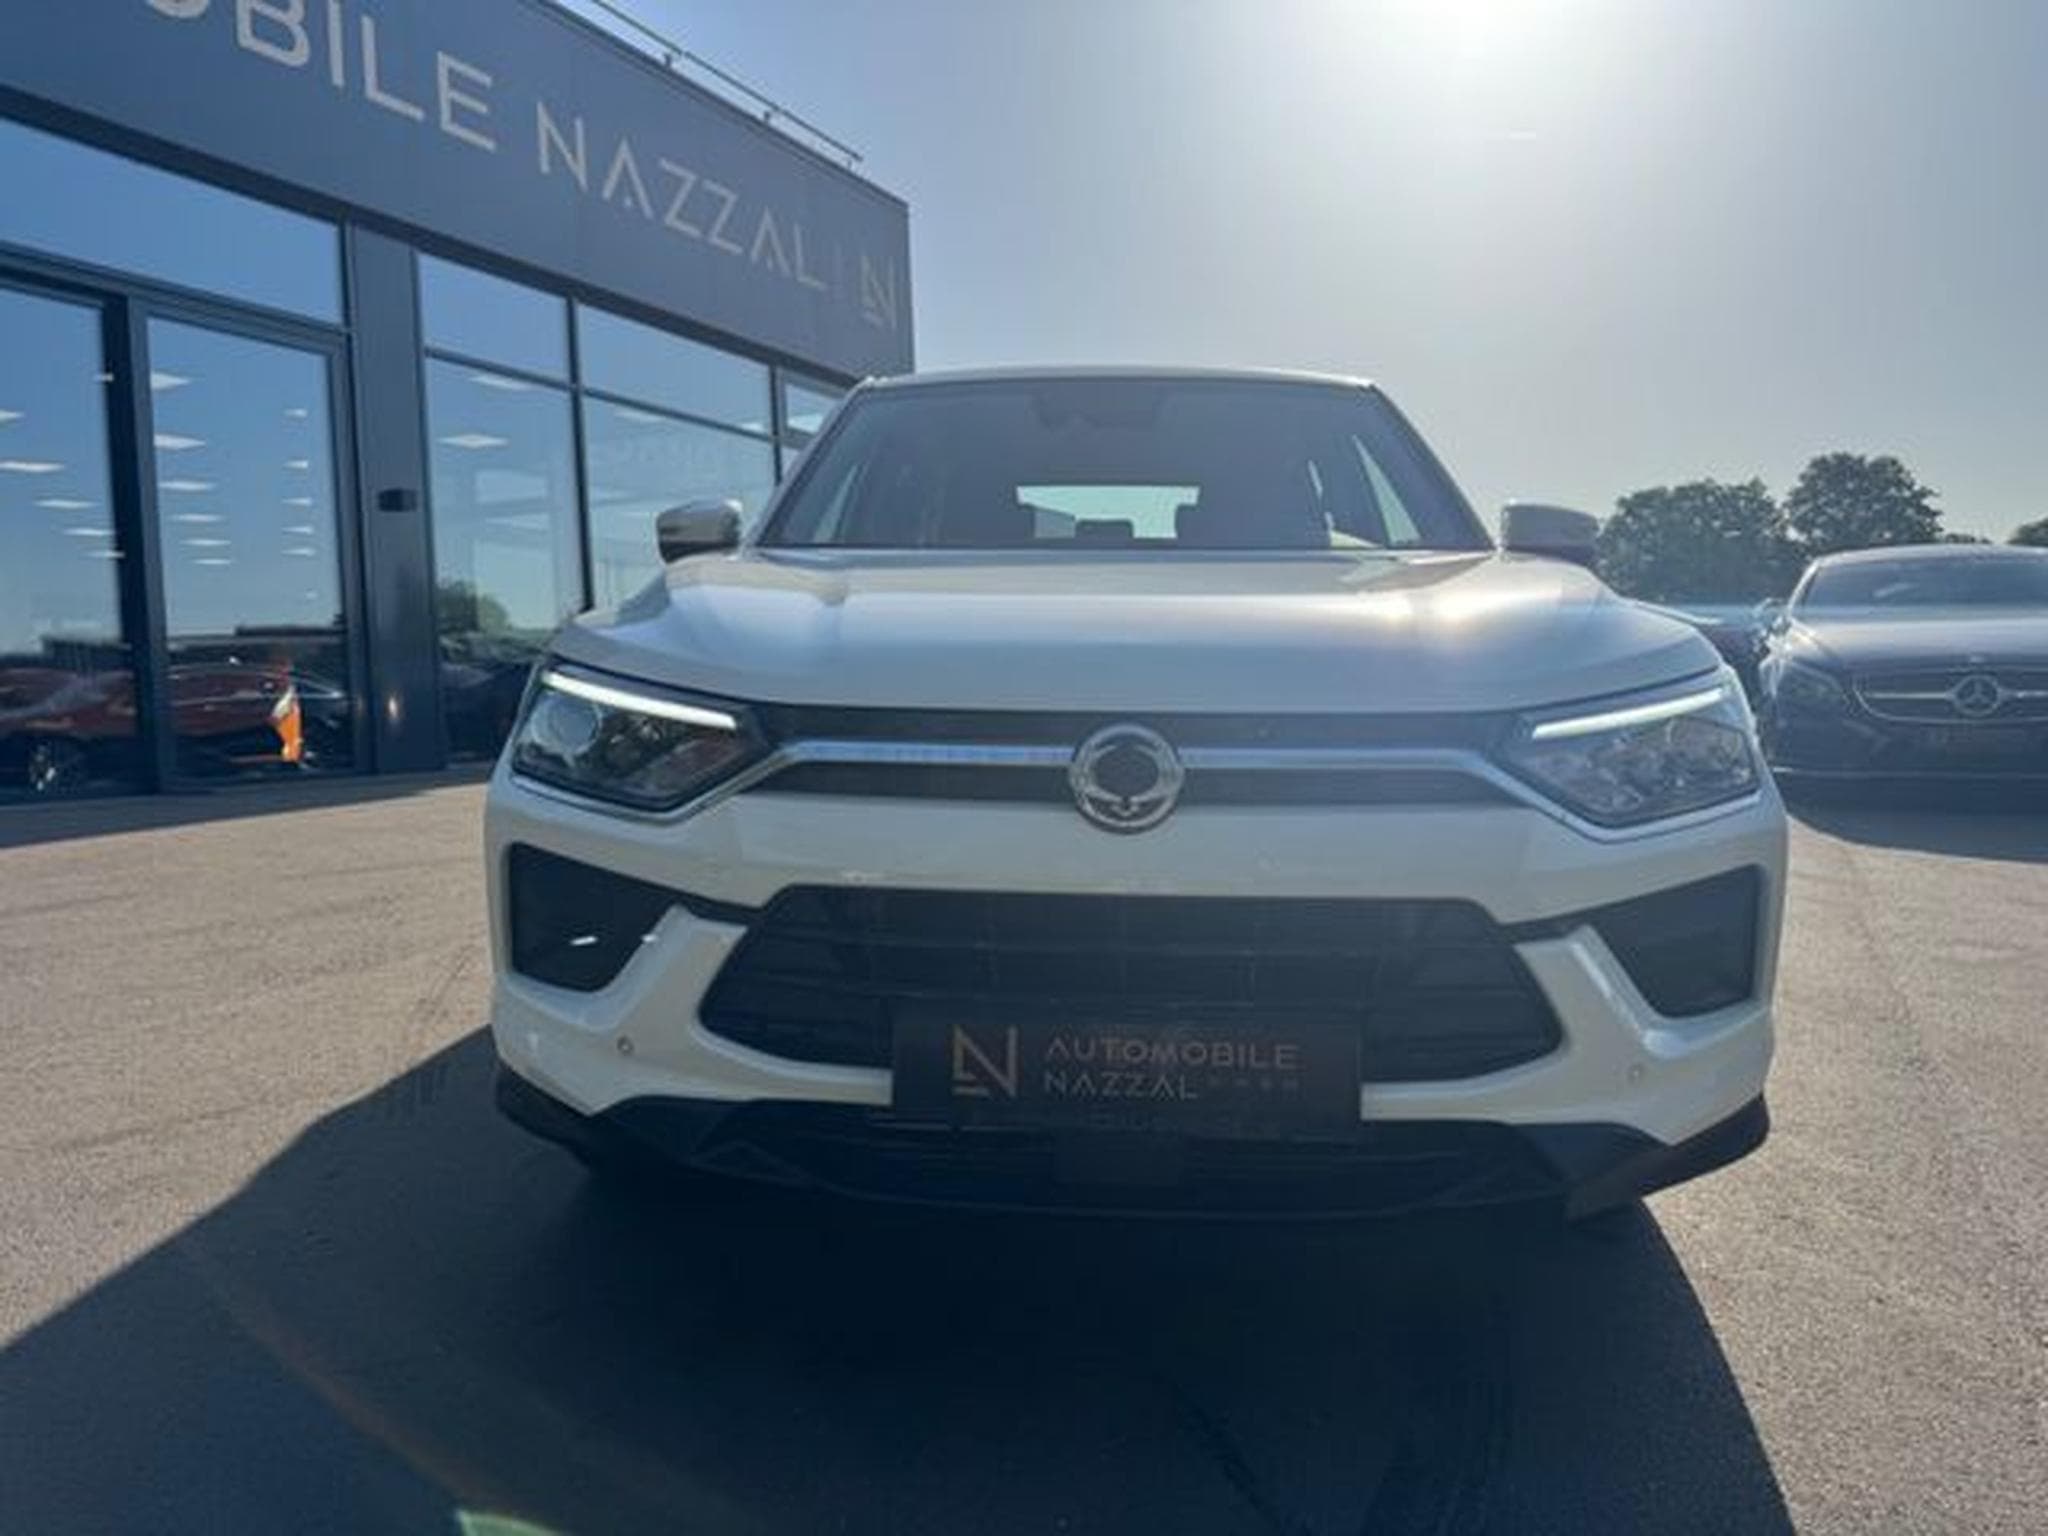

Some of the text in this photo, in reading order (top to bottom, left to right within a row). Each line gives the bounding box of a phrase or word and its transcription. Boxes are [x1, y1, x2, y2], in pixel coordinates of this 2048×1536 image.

[143, 0, 495, 152] BILE
[536, 100, 827, 290] NAZZAL
[1045, 1037, 1300, 1069] AUTOMOBILE
[1045, 1072, 1199, 1100] NAZZAL
